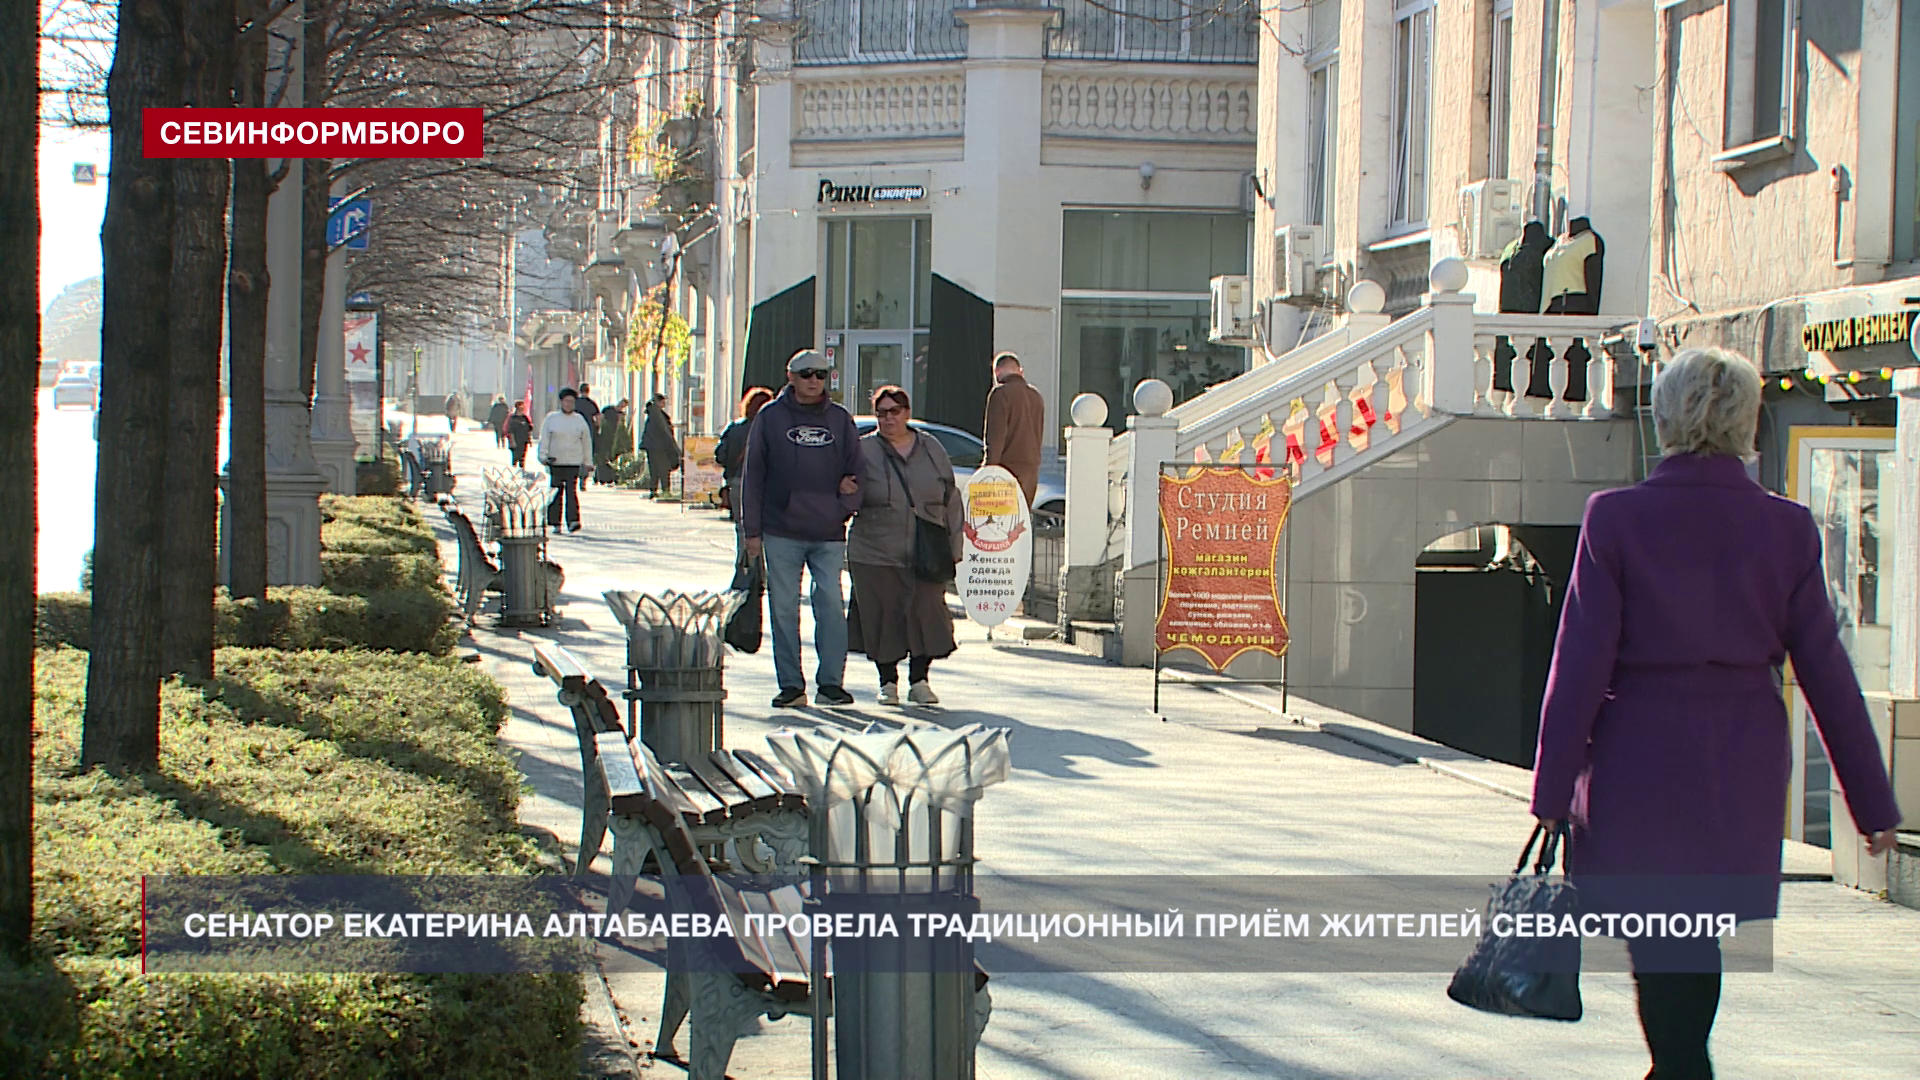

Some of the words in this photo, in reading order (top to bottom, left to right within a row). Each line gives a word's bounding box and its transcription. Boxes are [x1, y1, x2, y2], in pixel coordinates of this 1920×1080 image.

[1802, 318, 1852, 352] СТУДИЯ
[1178, 485, 1267, 515] Студия
[1176, 517, 1268, 540] Ремней
[969, 553, 1015, 563] Женская
[1195, 553, 1248, 563] магазин
[971, 567, 1011, 575] одежда
[966, 589, 1015, 599] размеров
[1166, 633, 1275, 645] ЧЕМОДАНЫ
